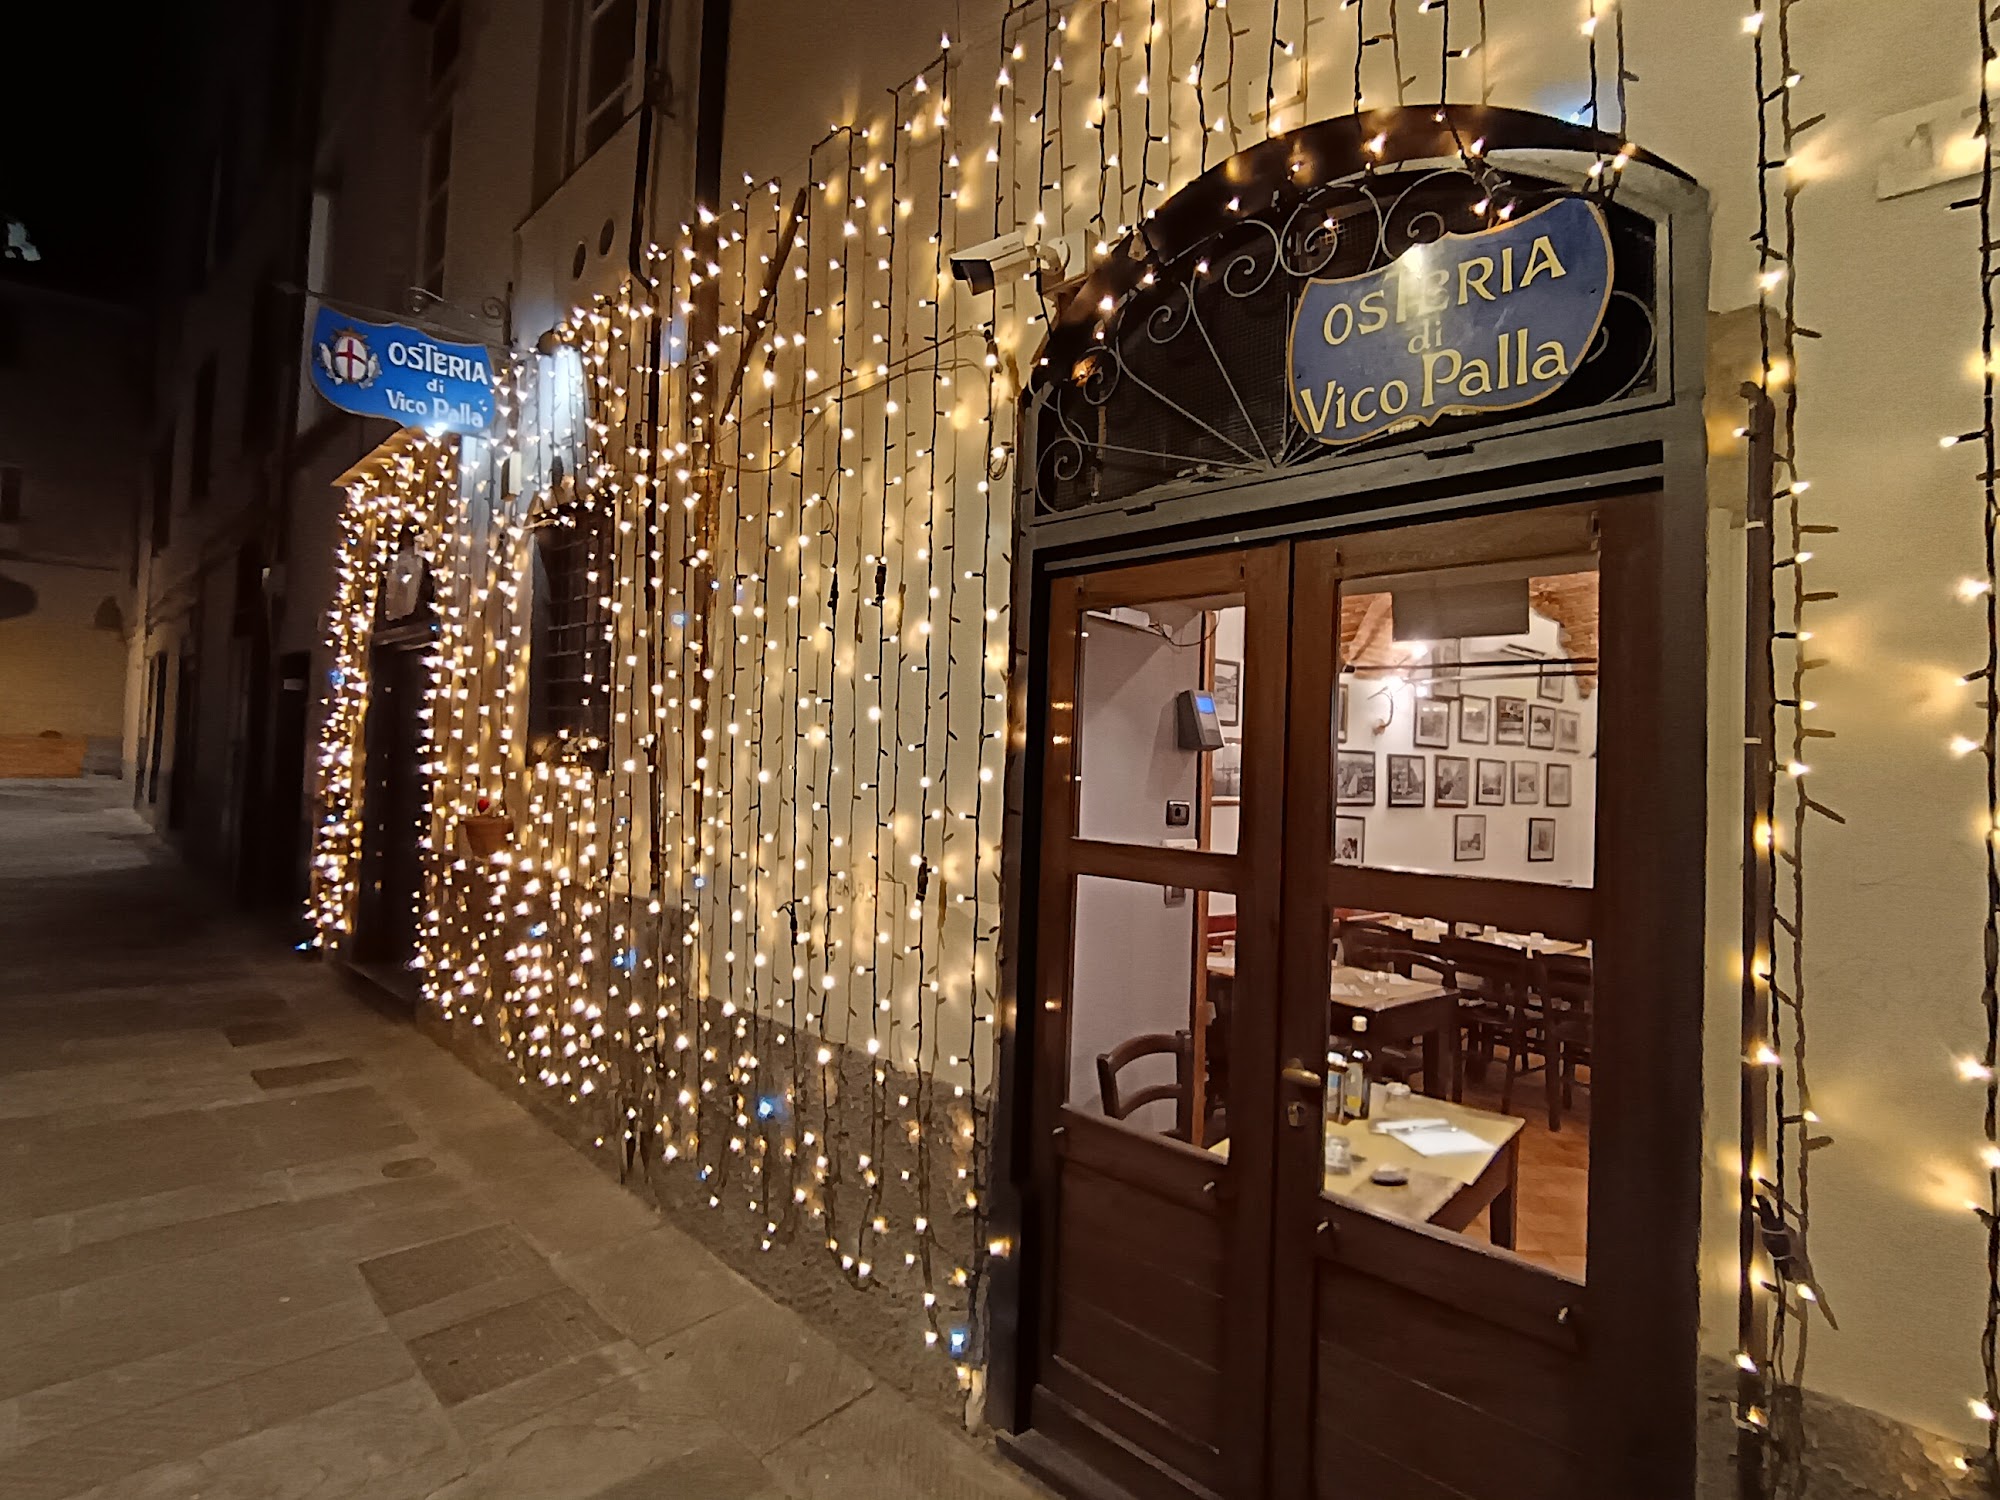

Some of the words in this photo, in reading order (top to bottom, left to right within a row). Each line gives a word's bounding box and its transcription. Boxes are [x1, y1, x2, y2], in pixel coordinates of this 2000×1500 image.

[1323, 235, 1567, 346] OSTERIA
[1407, 319, 1442, 354] di
[426, 377, 445, 394] di
[1300, 380, 1409, 434] Vico
[1421, 328, 1569, 407] Palla
[385, 388, 428, 416] Vico
[432, 397, 484, 428] Palla
